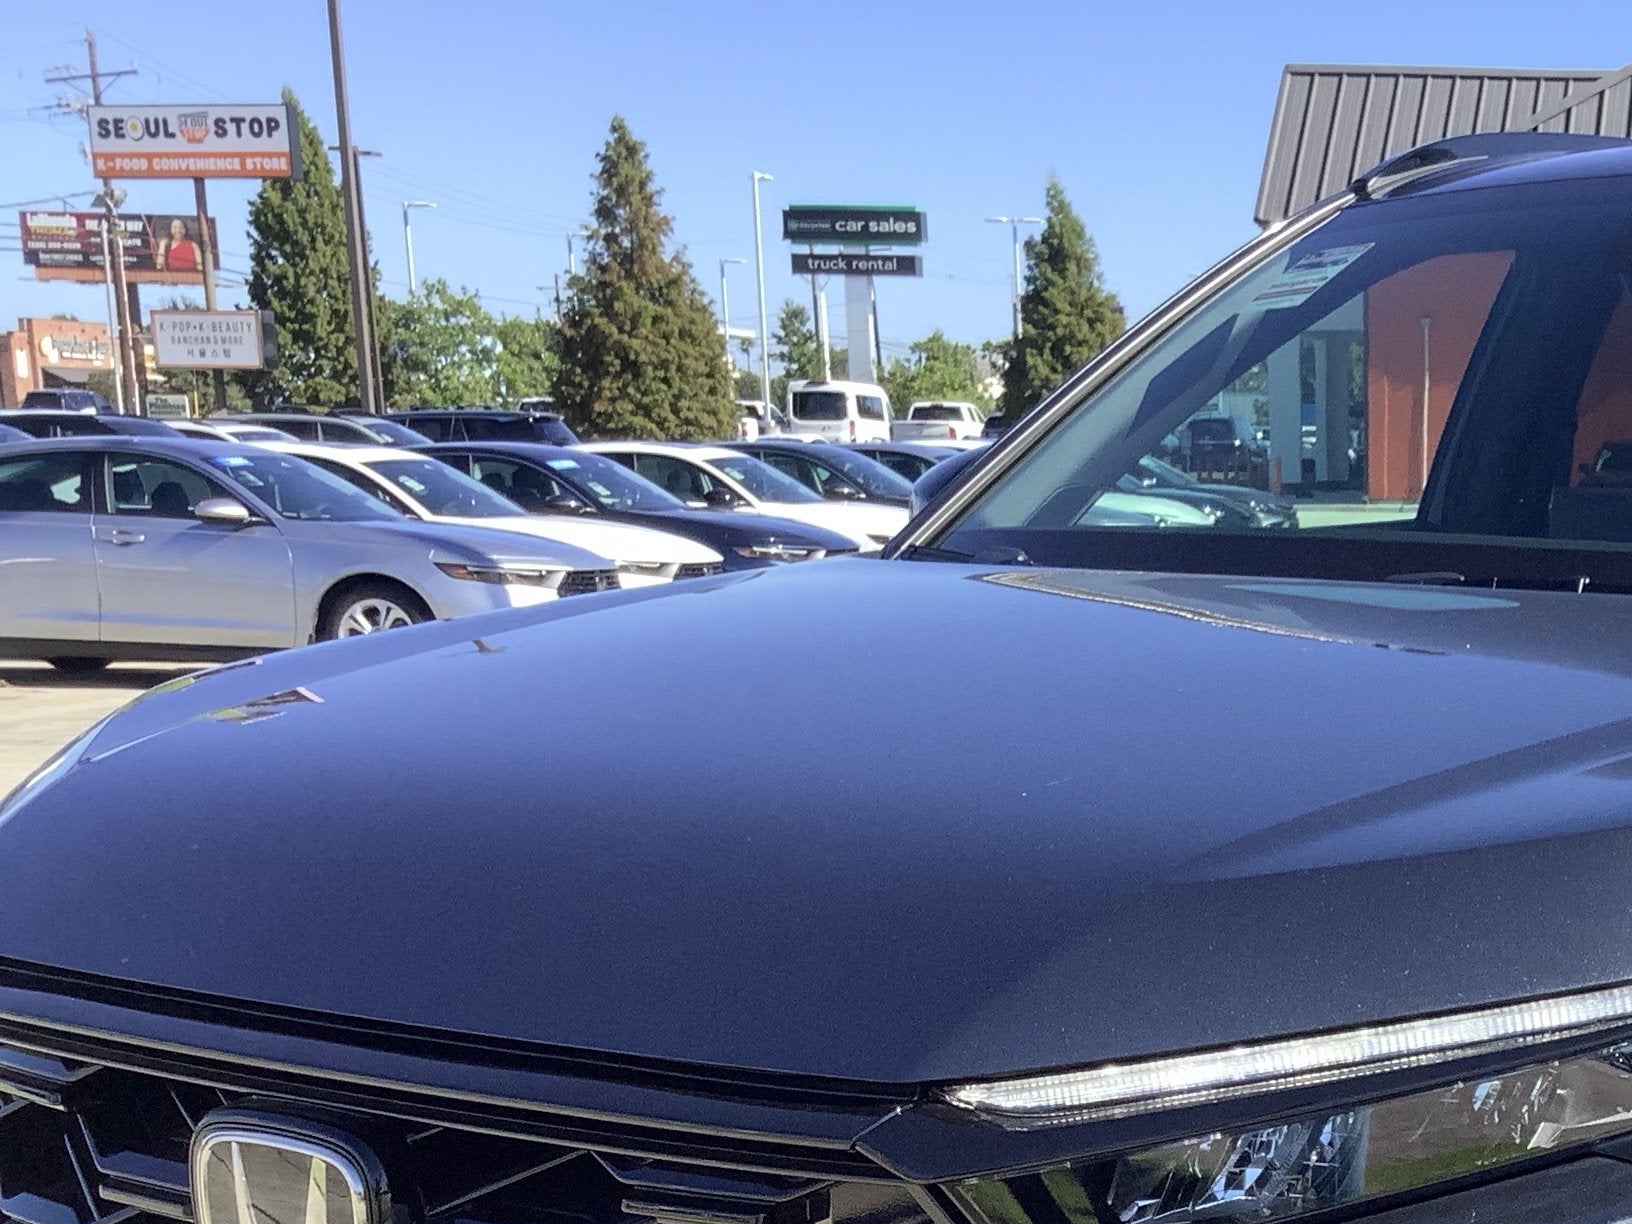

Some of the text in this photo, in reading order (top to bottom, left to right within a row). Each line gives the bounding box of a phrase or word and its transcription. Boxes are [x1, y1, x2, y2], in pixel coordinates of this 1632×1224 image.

[213, 117, 280, 139] STOP
[153, 158, 241, 171] CONVENIENCE
[245, 157, 288, 171] STORE
[835, 220, 865, 232] car
[868, 217, 917, 233] sales
[807, 257, 898, 271] truck rental
